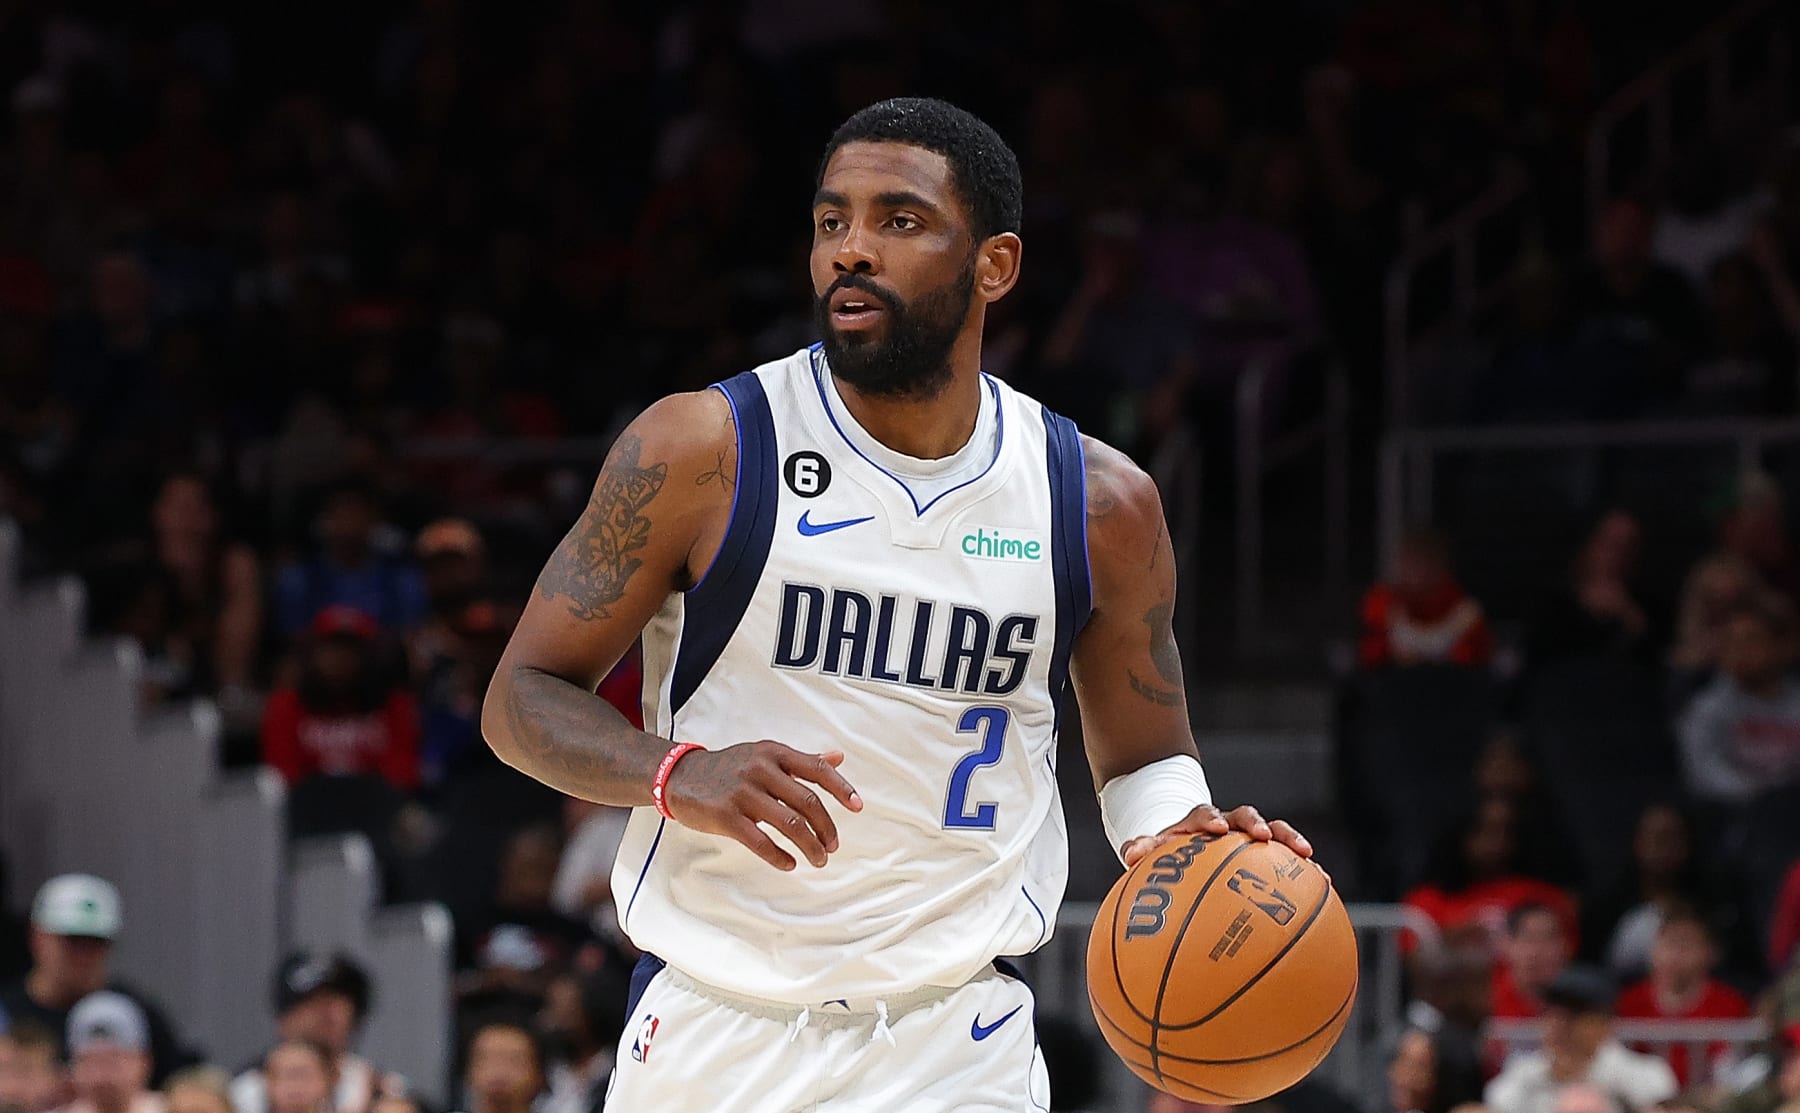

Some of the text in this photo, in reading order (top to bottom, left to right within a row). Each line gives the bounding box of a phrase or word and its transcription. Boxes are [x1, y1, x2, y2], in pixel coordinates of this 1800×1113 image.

[793, 456, 819, 492] 6
[961, 528, 1041, 560] chime
[770, 580, 1040, 697] DALLAS
[941, 704, 1012, 832] 2
[1124, 833, 1217, 942] Wilso
